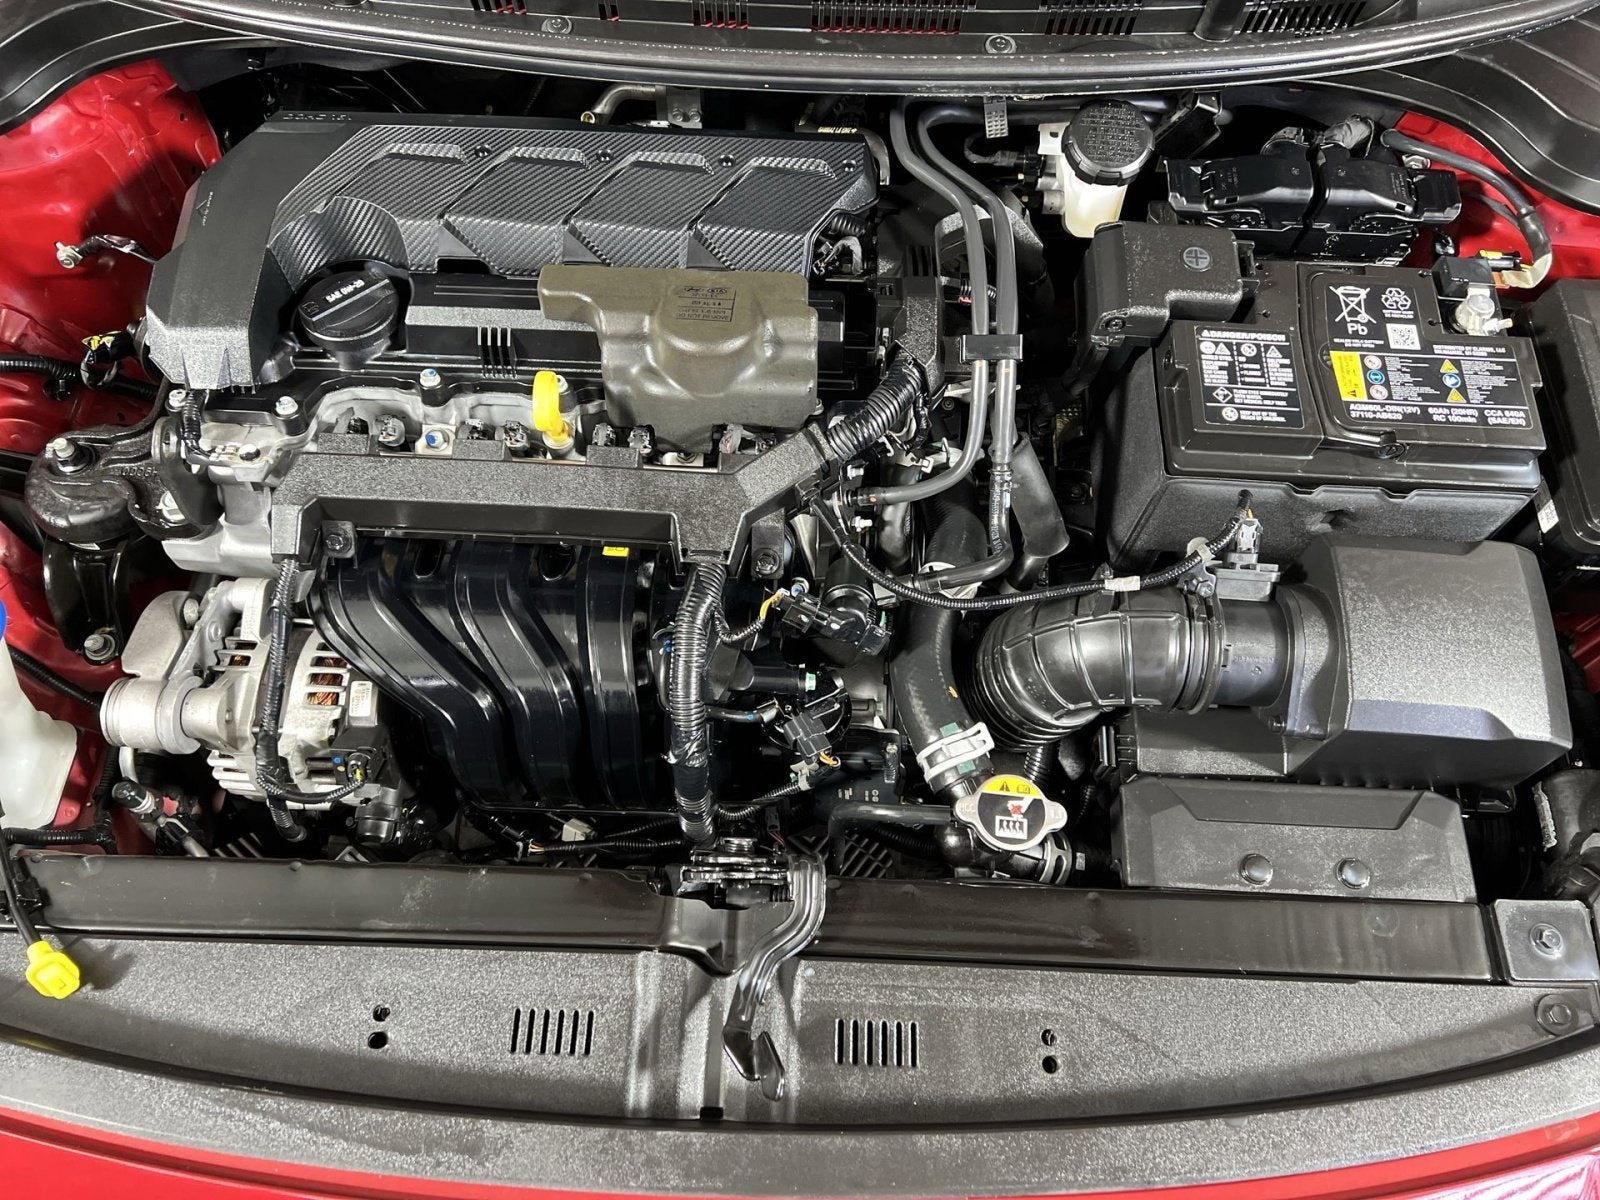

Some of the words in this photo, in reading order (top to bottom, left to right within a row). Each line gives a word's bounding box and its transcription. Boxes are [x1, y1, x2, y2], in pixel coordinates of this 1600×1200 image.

[325, 290, 343, 303] SAE
[340, 279, 365, 296] 0W-20
[1346, 323, 1368, 335] Pb
[1209, 331, 1286, 342] DANGER/POISON
[1428, 407, 1450, 415] 60Ah
[1450, 408, 1479, 417] (20HR)
[1484, 409, 1506, 418] CCA
